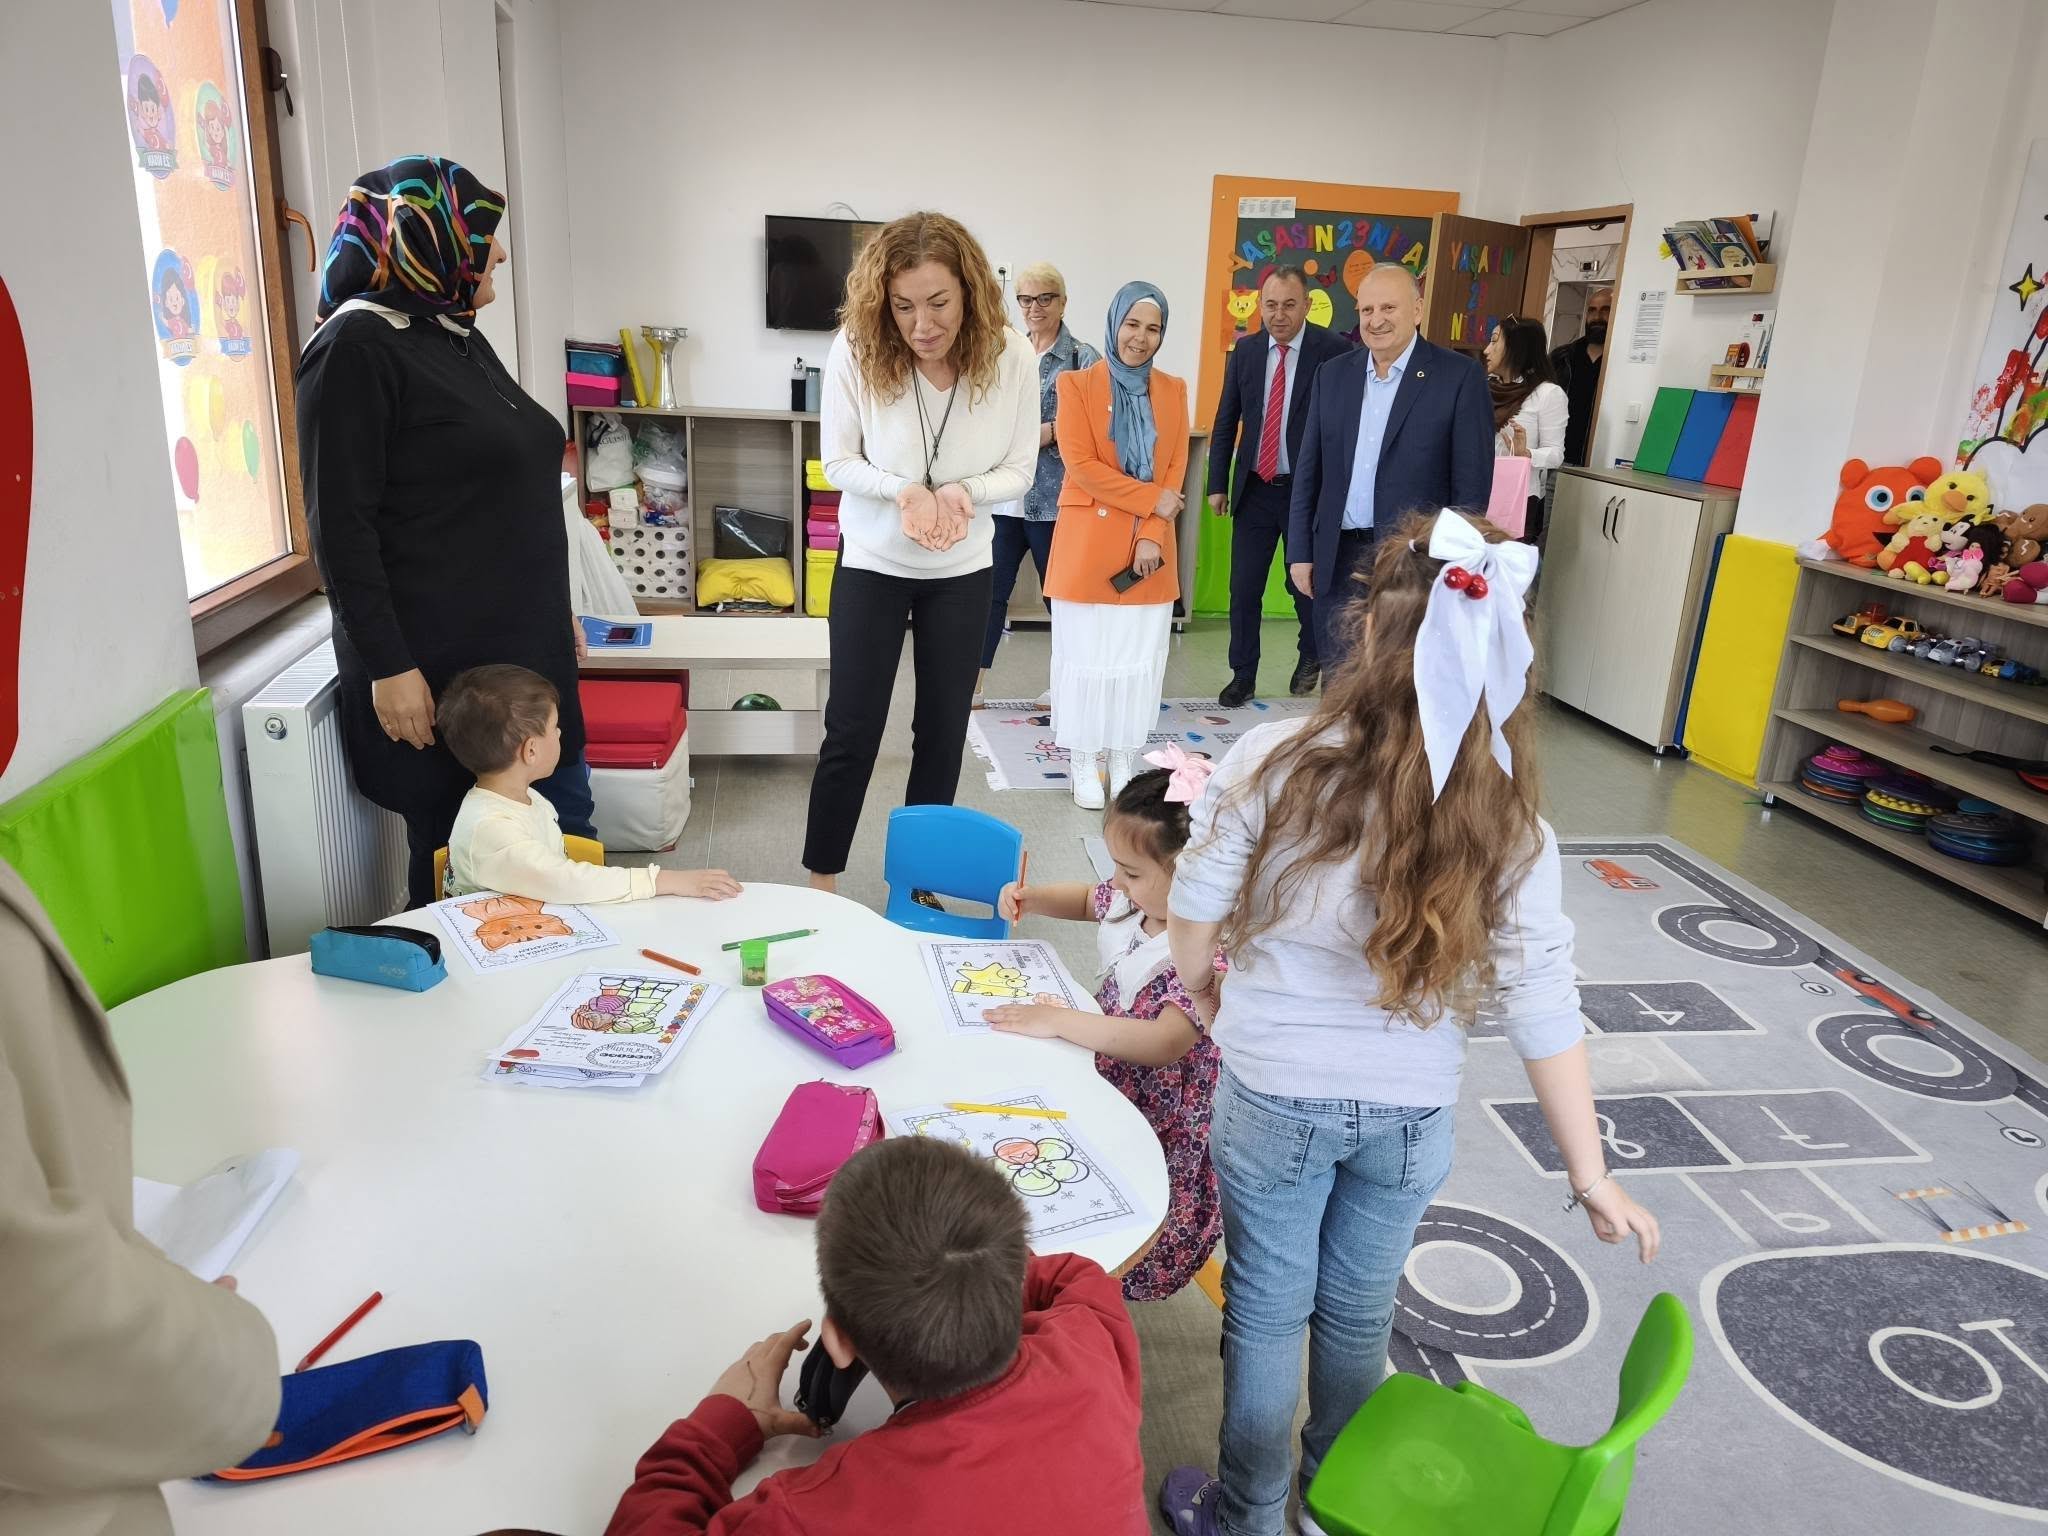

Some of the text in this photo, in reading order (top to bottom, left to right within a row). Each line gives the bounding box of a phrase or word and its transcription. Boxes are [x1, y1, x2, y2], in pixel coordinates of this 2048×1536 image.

[1336, 219, 1370, 249] 23
[1628, 991, 1686, 1026] 4
[1759, 1105, 1851, 1151] 7
